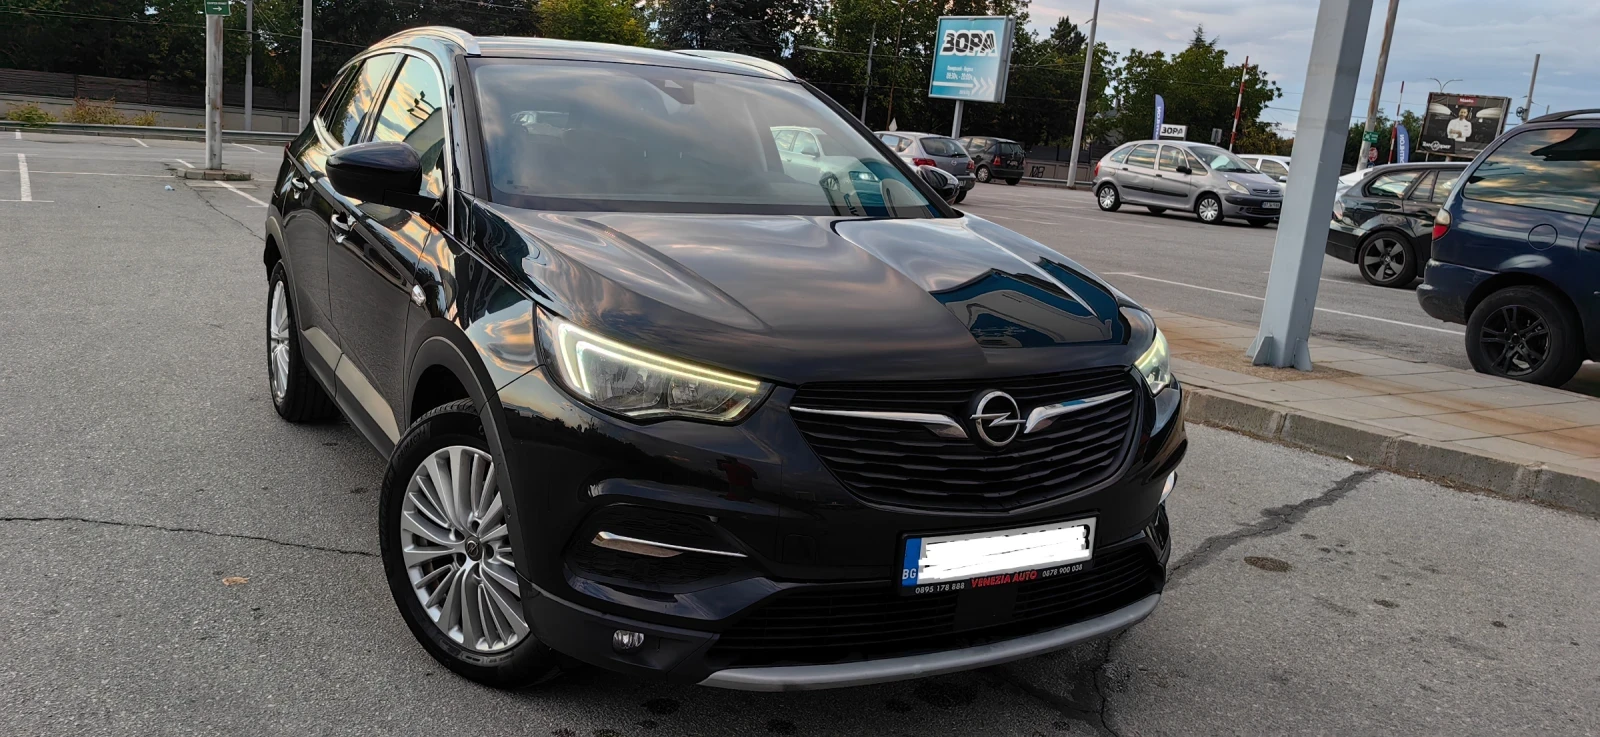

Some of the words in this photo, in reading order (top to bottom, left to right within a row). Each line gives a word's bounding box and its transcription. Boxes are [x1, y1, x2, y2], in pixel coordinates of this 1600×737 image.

[941, 31, 997, 55] ЗОРА
[1161, 126, 1183, 135] ЗОРА
[902, 568, 917, 580] BG
[915, 586, 934, 594] 0895
[936, 584, 950, 592] 178
[952, 582, 965, 590] 888
[971, 574, 1011, 588] VENEZIA
[1012, 570, 1038, 583] AUTO
[1042, 569, 1058, 577] 0878
[1059, 566, 1070, 574] 900
[1071, 564, 1083, 572] 038
